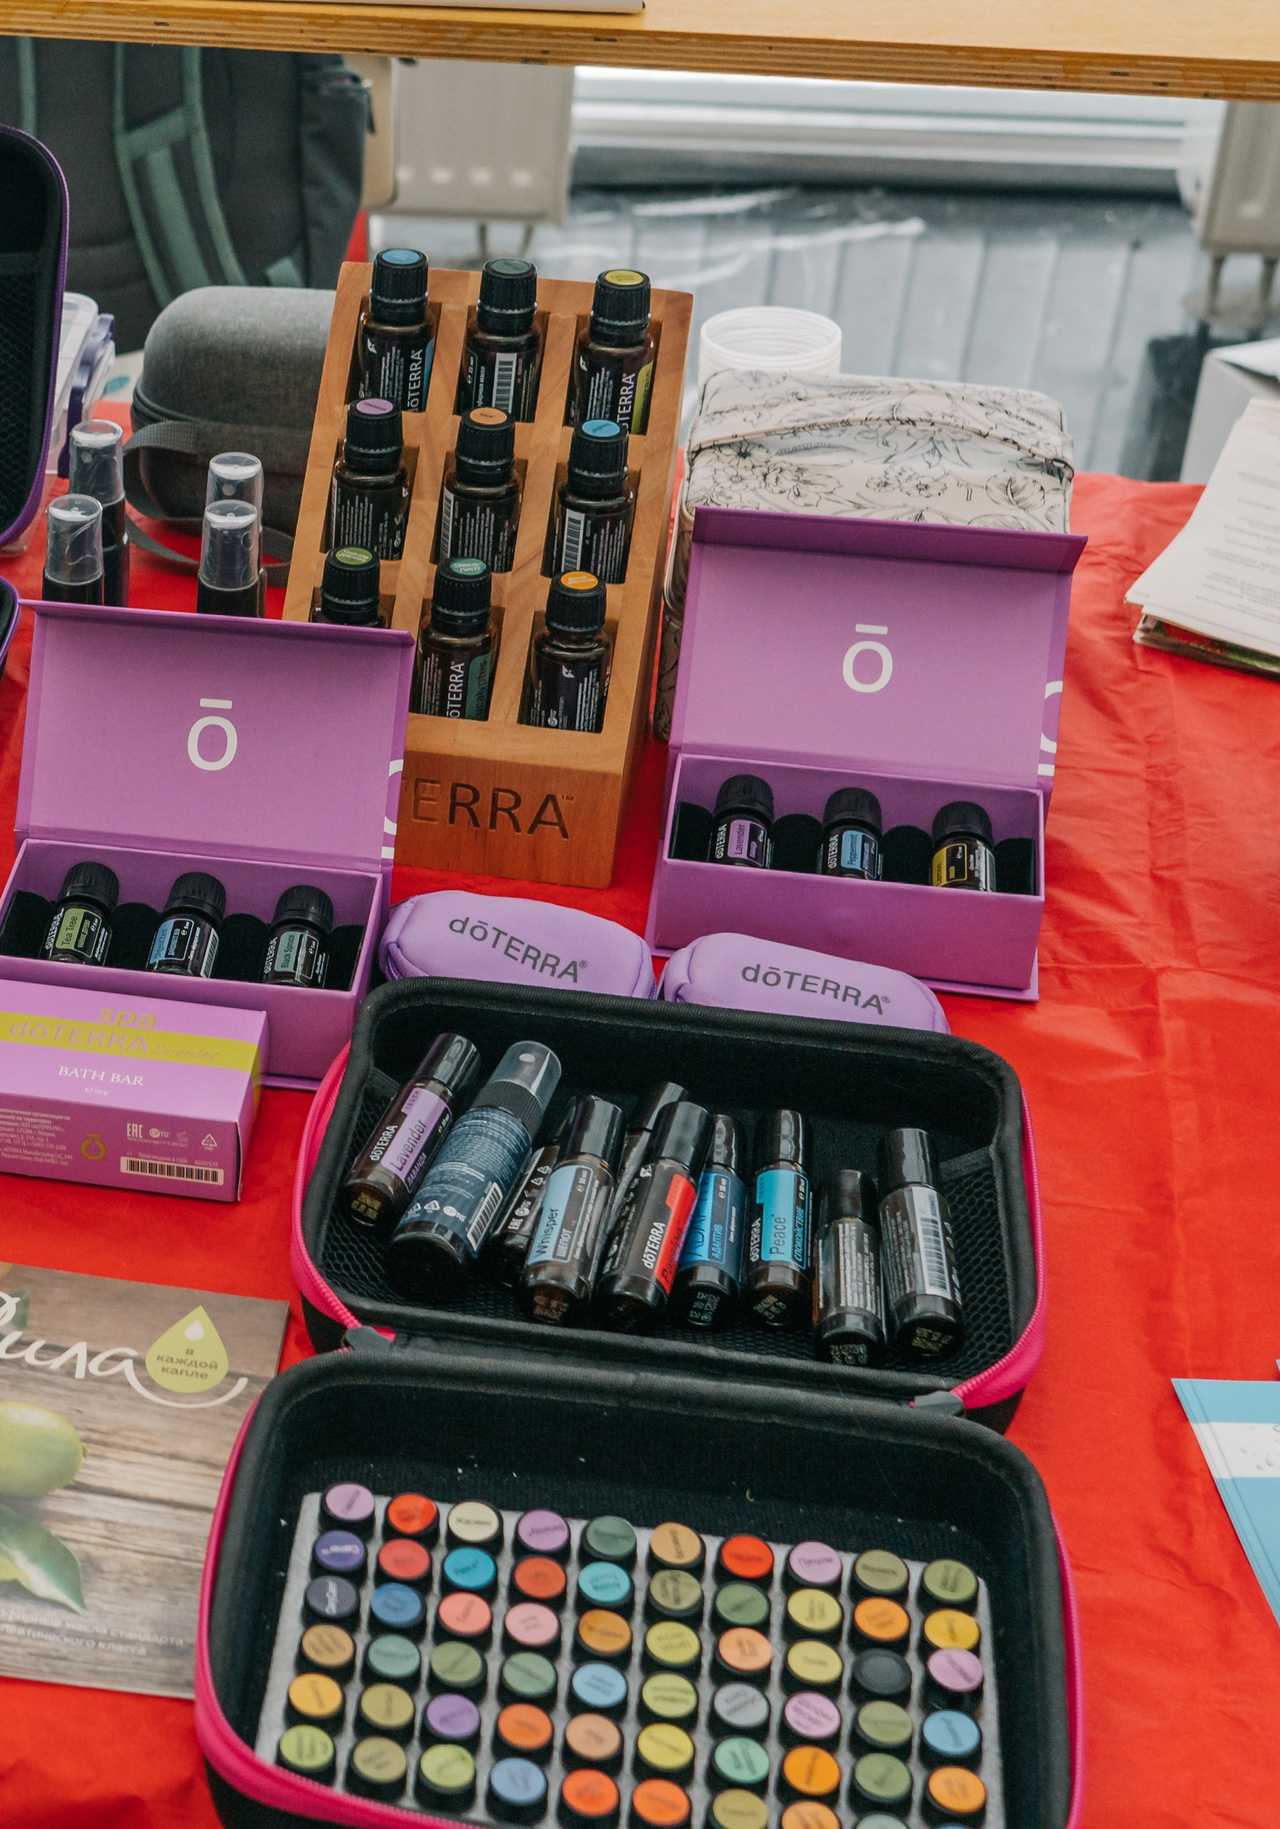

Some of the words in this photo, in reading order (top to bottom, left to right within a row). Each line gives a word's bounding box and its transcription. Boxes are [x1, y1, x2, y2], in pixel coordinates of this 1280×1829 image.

[733, 823, 745, 854] Lavender
[846, 833, 860, 865] Peppermint
[65, 914, 77, 932] Tree
[61, 931, 73, 946] Tea
[280, 952, 292, 969] Black
[97, 1007, 157, 1027] spa
[9, 1021, 149, 1053] dōTERRA
[58, 1065, 106, 1083] BATH
[110, 1070, 144, 1086] BAR
[369, 1124, 398, 1162] dōTERRA
[388, 1118, 428, 1173] Lavender
[534, 1206, 561, 1259] Whisper
[554, 1227, 573, 1257] ШЕПОТ
[641, 1220, 666, 1270] dōTERRA
[769, 1215, 788, 1255] Peace
[790, 1205, 807, 1261] СПОКОЙСТВИЕ
[155, 1353, 218, 1372] каждой
[160, 1364, 209, 1381] капле
[65, 1619, 107, 1635] масла
